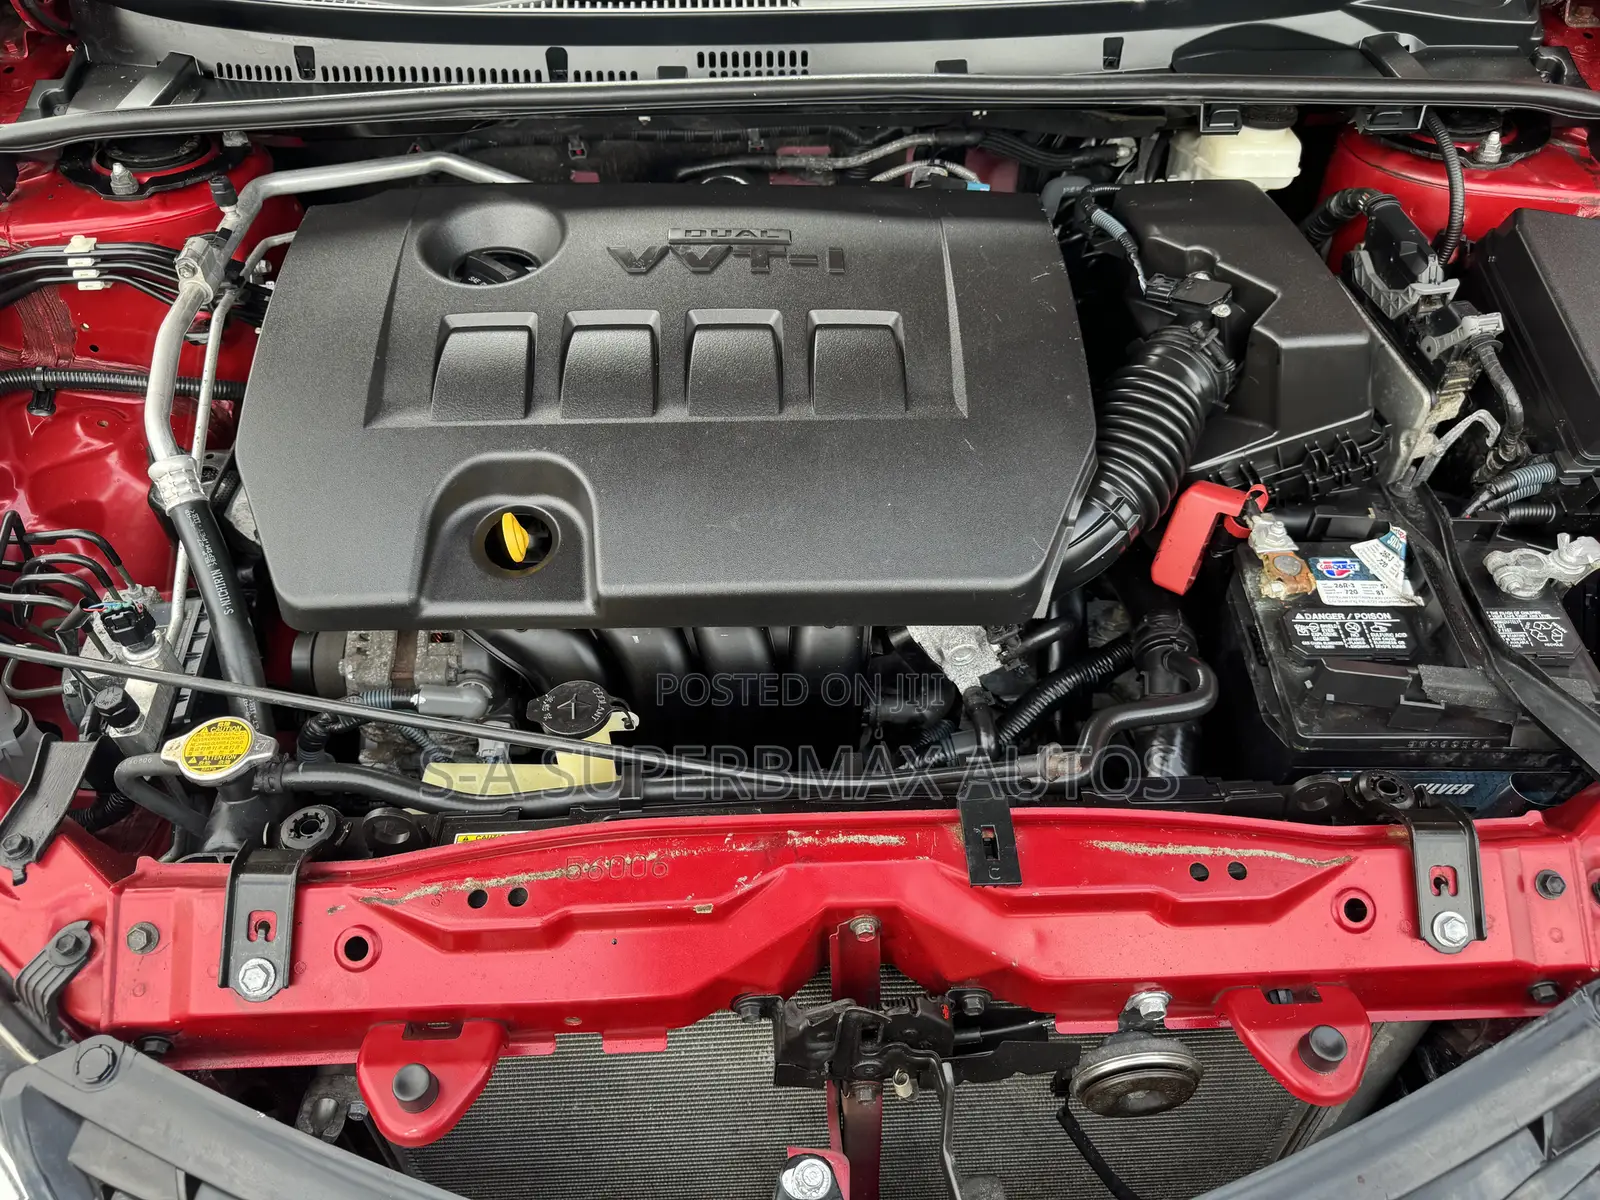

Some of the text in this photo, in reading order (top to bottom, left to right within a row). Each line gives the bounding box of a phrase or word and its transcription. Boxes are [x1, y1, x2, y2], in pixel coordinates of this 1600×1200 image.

[684, 229, 780, 238] DUAL
[1304, 612, 1346, 620] DANGER
[1353, 612, 1392, 620] POISON
[592, 687, 607, 723] COOLANT
[564, 854, 669, 882] 56006
